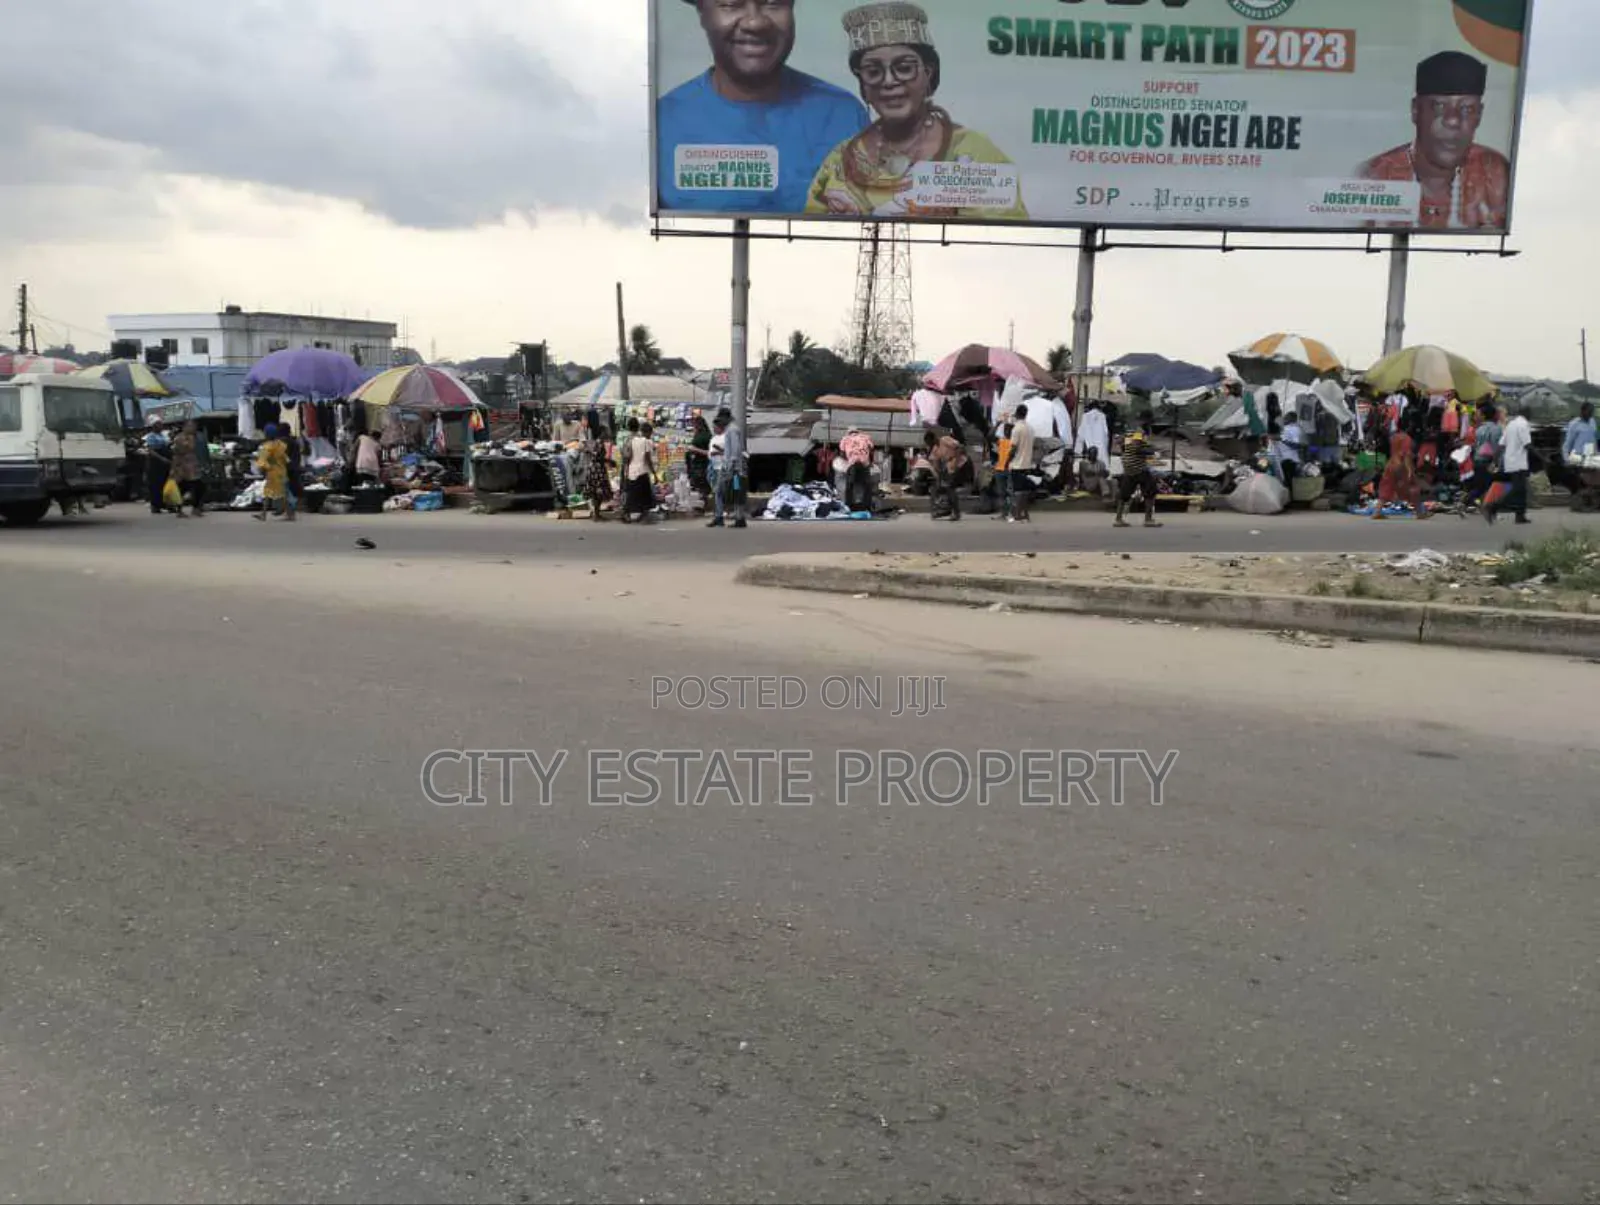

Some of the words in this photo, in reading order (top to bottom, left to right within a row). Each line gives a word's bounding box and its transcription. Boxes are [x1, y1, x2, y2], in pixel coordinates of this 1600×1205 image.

[987, 17, 1132, 60] SMART
[1141, 24, 1239, 65] PATH
[1255, 29, 1347, 69] 2023
[1143, 80, 1199, 94] SUPPORT
[1091, 96, 1186, 111] DISTINGUISHED
[1190, 99, 1248, 113] SENATOR
[1031, 107, 1164, 148] MAGNUS
[1170, 113, 1239, 148] NGEI
[1244, 116, 1302, 150] ABE
[718, 161, 771, 173] MAGNUS
[1069, 150, 1094, 163] FOR
[1182, 153, 1223, 166] RIVERS
[1227, 154, 1262, 167] STATE
[680, 173, 727, 187] NGEI
[733, 173, 773, 188] ABE
[1076, 186, 1120, 206] SDP
